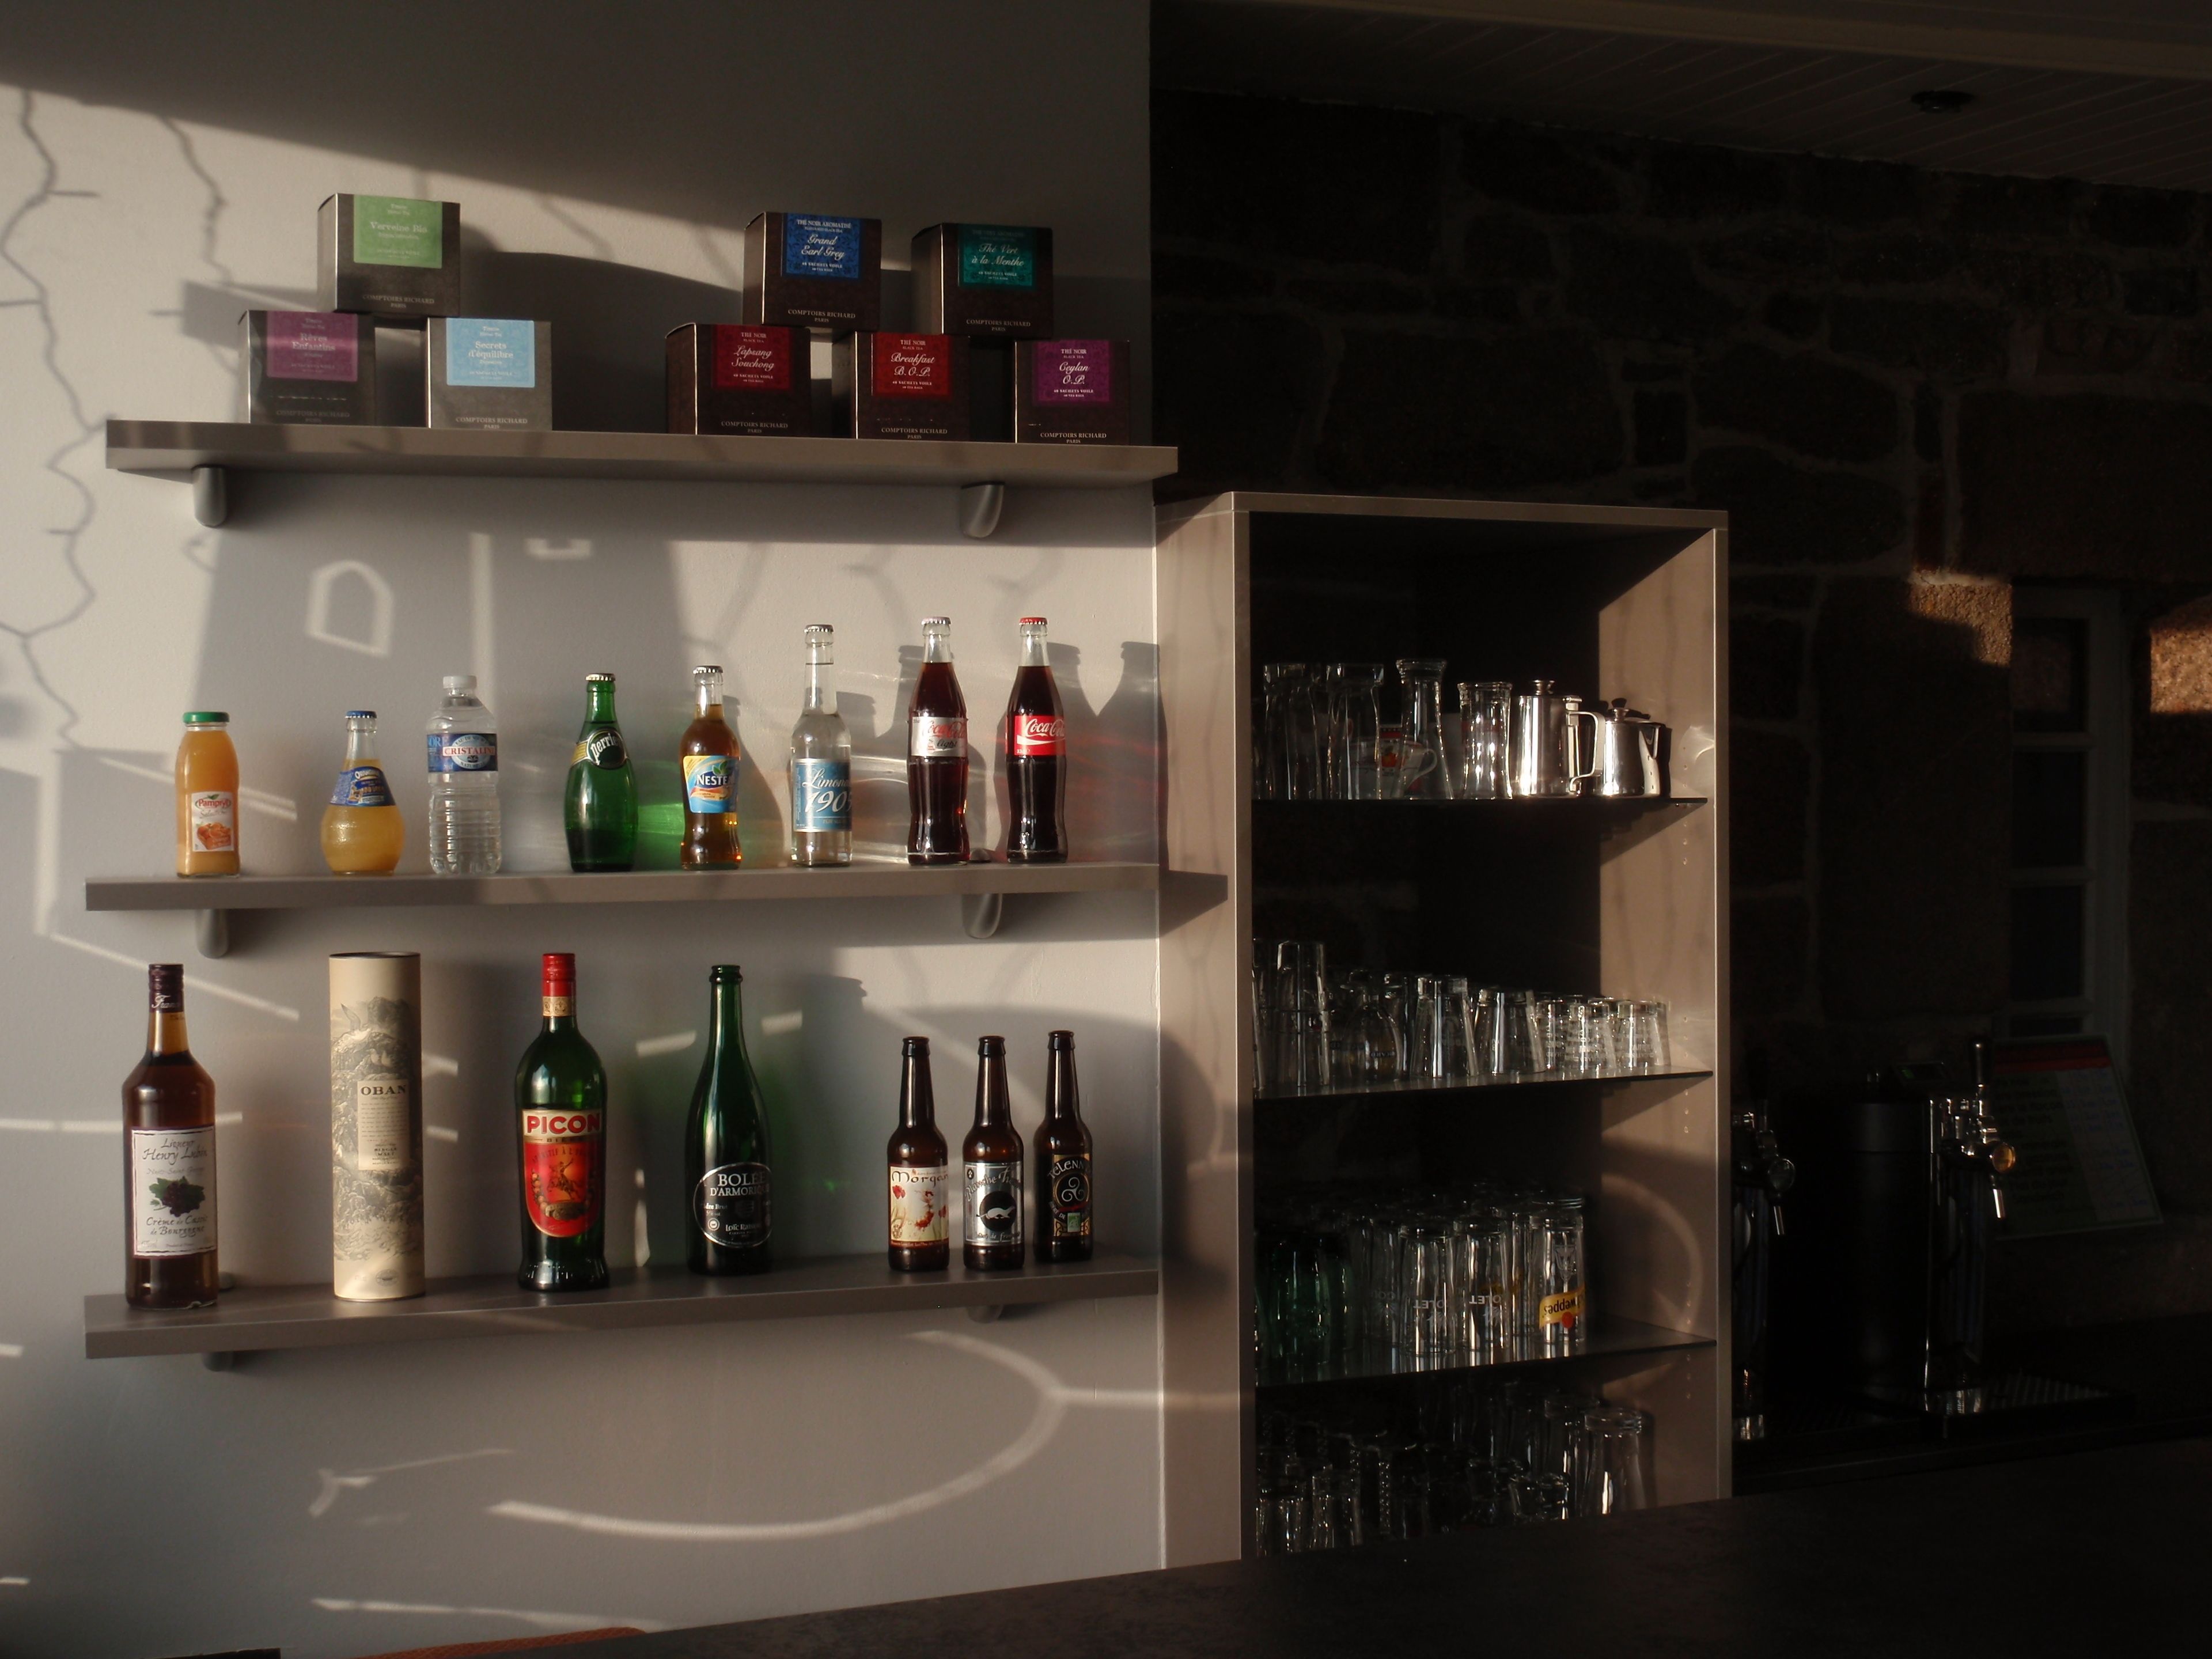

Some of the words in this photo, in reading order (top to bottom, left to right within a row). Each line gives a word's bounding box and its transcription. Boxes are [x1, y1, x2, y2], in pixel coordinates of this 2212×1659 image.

[370, 221, 410, 231] Verveine
[413, 225, 427, 233] Bio
[808, 233, 838, 245] Grand
[801, 245, 824, 256] Earl
[824, 247, 845, 260] Grey
[979, 243, 995, 252] Thé
[1000, 245, 1018, 253] Vert
[980, 255, 990, 264] la
[991, 256, 1024, 266] Menthe
[404, 296, 434, 304] RICHARD
[301, 332, 327, 342] Rêves
[292, 341, 336, 351] Enfantins
[475, 340, 507, 349] Secrets
[468, 350, 513, 359] d'équilibre
[733, 345, 772, 359] Lapsang
[731, 358, 774, 372] Souchong
[891, 353, 935, 366] Breakfast
[1059, 361, 1090, 374] Ceylan
[937, 739, 957, 749] light
[361, 1085, 406, 1096] OBAN
[527, 1113, 600, 1134] PICON
[143, 1148, 179, 1165] Henry
[146, 1217, 174, 1226] Crème
[159, 1226, 204, 1238] Bourgogne
